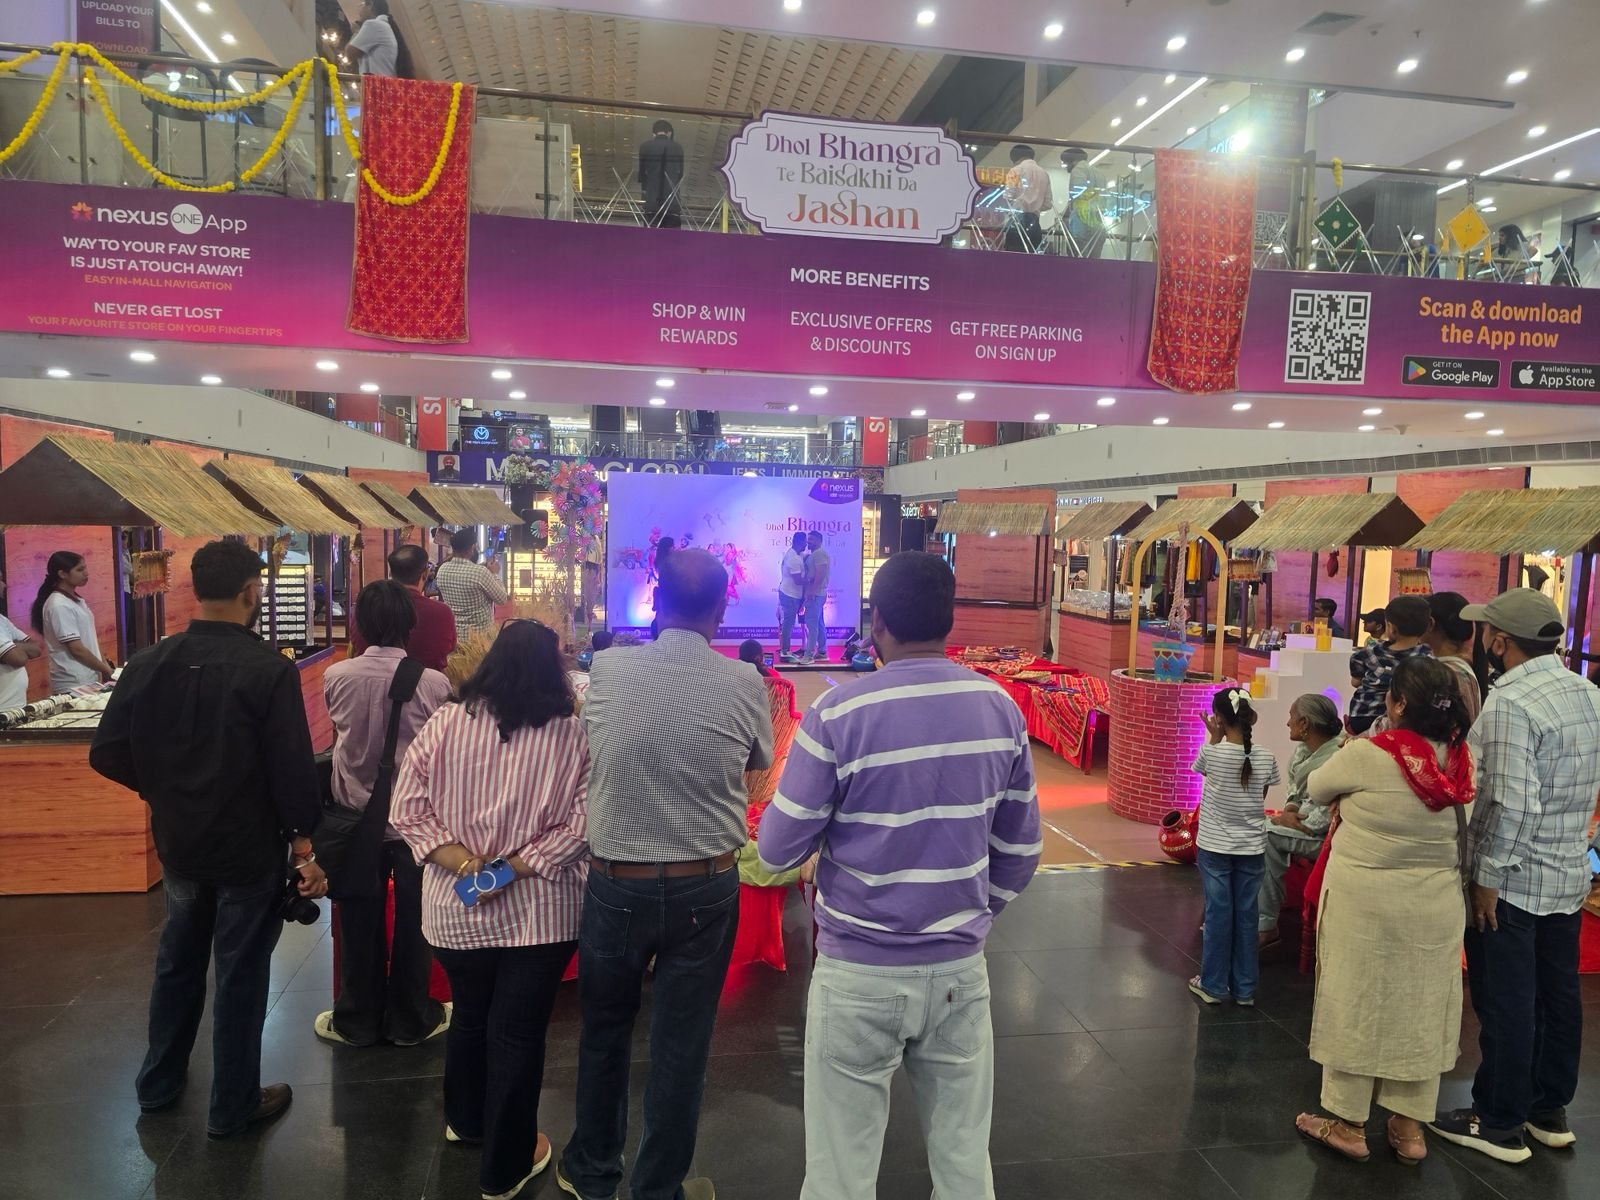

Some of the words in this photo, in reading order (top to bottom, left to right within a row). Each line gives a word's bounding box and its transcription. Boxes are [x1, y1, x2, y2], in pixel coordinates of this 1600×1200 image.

[82, 1, 124, 12] UPLOAD
[125, 5, 154, 16] YOUR
[95, 16, 125, 27] BILLS
[126, 19, 140, 29] TO
[766, 133, 810, 156] Dhol
[819, 132, 941, 173] Bhangra
[776, 166, 795, 183] Te
[801, 161, 892, 190] Baisakhi
[898, 177, 917, 192] Da
[97, 207, 169, 226] nexus
[172, 212, 201, 225] ONE
[205, 214, 248, 235] App
[787, 191, 920, 230] Jashan
[63, 236, 97, 250] WAY
[98, 239, 120, 251] TO
[121, 240, 165, 254] YOUR
[168, 243, 198, 256] FAV
[200, 245, 251, 260] STORE
[71, 256, 86, 268] IS
[87, 257, 126, 270] JUST
[127, 260, 139, 271] A
[139, 260, 194, 274] TOUCH
[196, 263, 244, 277] AWAY!
[84, 274, 115, 285] EASY
[115, 275, 163, 288] IN-MALL
[164, 279, 233, 291] NAVIGATION
[790, 268, 842, 285] MORE
[846, 271, 930, 291] BENEFITS
[94, 302, 148, 316] NEVER
[150, 304, 182, 318] GET
[184, 306, 223, 320] LOST
[652, 302, 697, 320] SHOP
[699, 305, 711, 320] &
[714, 307, 746, 322] WIN
[1419, 296, 1466, 319] Scan
[1470, 300, 1485, 319] &
[1489, 300, 1582, 324] download
[27, 315, 60, 326] YOUR
[61, 316, 126, 330] FAVOURITE
[128, 320, 165, 332] STORE
[167, 322, 184, 333] ON
[184, 323, 217, 334] YOUR
[218, 325, 284, 338] FINGERTIPS
[790, 311, 872, 330] EXCLUSIVE
[875, 317, 932, 333] OFFERS
[950, 321, 979, 336] GET
[982, 323, 1017, 339] FREE
[1020, 325, 1083, 342] PARKING
[660, 328, 738, 346] REWARDS
[810, 337, 822, 351] &
[824, 338, 911, 356] DISCOUNTS
[1441, 323, 1473, 344] the
[1477, 325, 1515, 350] App
[1520, 331, 1559, 348] now
[975, 345, 996, 359] ON
[1000, 346, 1034, 361] SIGN
[1037, 348, 1056, 362] UP
[1431, 369, 1470, 384] Google
[1472, 371, 1494, 385] Play
[1541, 366, 1571, 374] Available
[1581, 366, 1593, 374] the
[1539, 374, 1563, 388] App
[1565, 375, 1596, 388] Store
[830, 484, 854, 492] nexus
[787, 516, 851, 537] Bhangra
